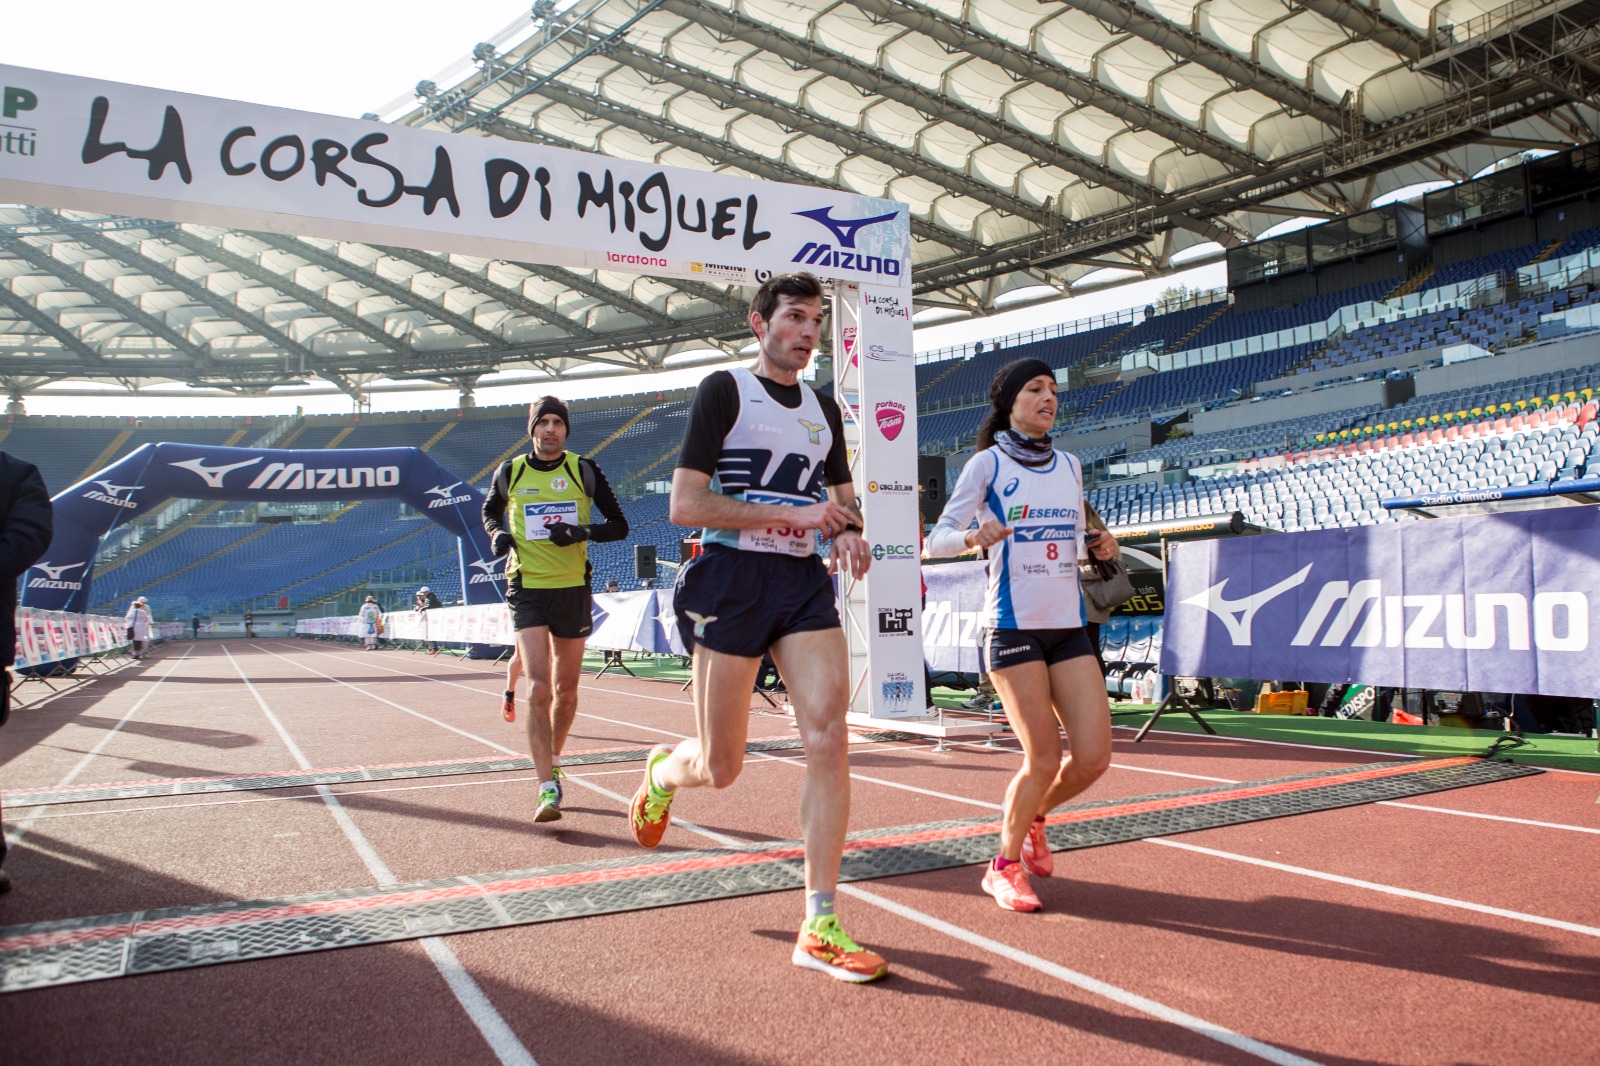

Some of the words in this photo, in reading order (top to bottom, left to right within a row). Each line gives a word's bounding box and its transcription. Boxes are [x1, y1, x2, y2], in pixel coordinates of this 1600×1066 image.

[81, 95, 192, 185] LA
[220, 125, 461, 218] CORSA
[790, 241, 900, 277] MIZUNO
[247, 462, 401, 491] MIZUNO
[1420, 495, 1453, 506] Stadio
[1454, 490, 1503, 504] Olimpico
[886, 545, 915, 555] BCC
[1046, 543, 1059, 561] 8
[1290, 579, 1590, 652] MIZUNO
[998, 645, 1031, 656] ESERCITO
